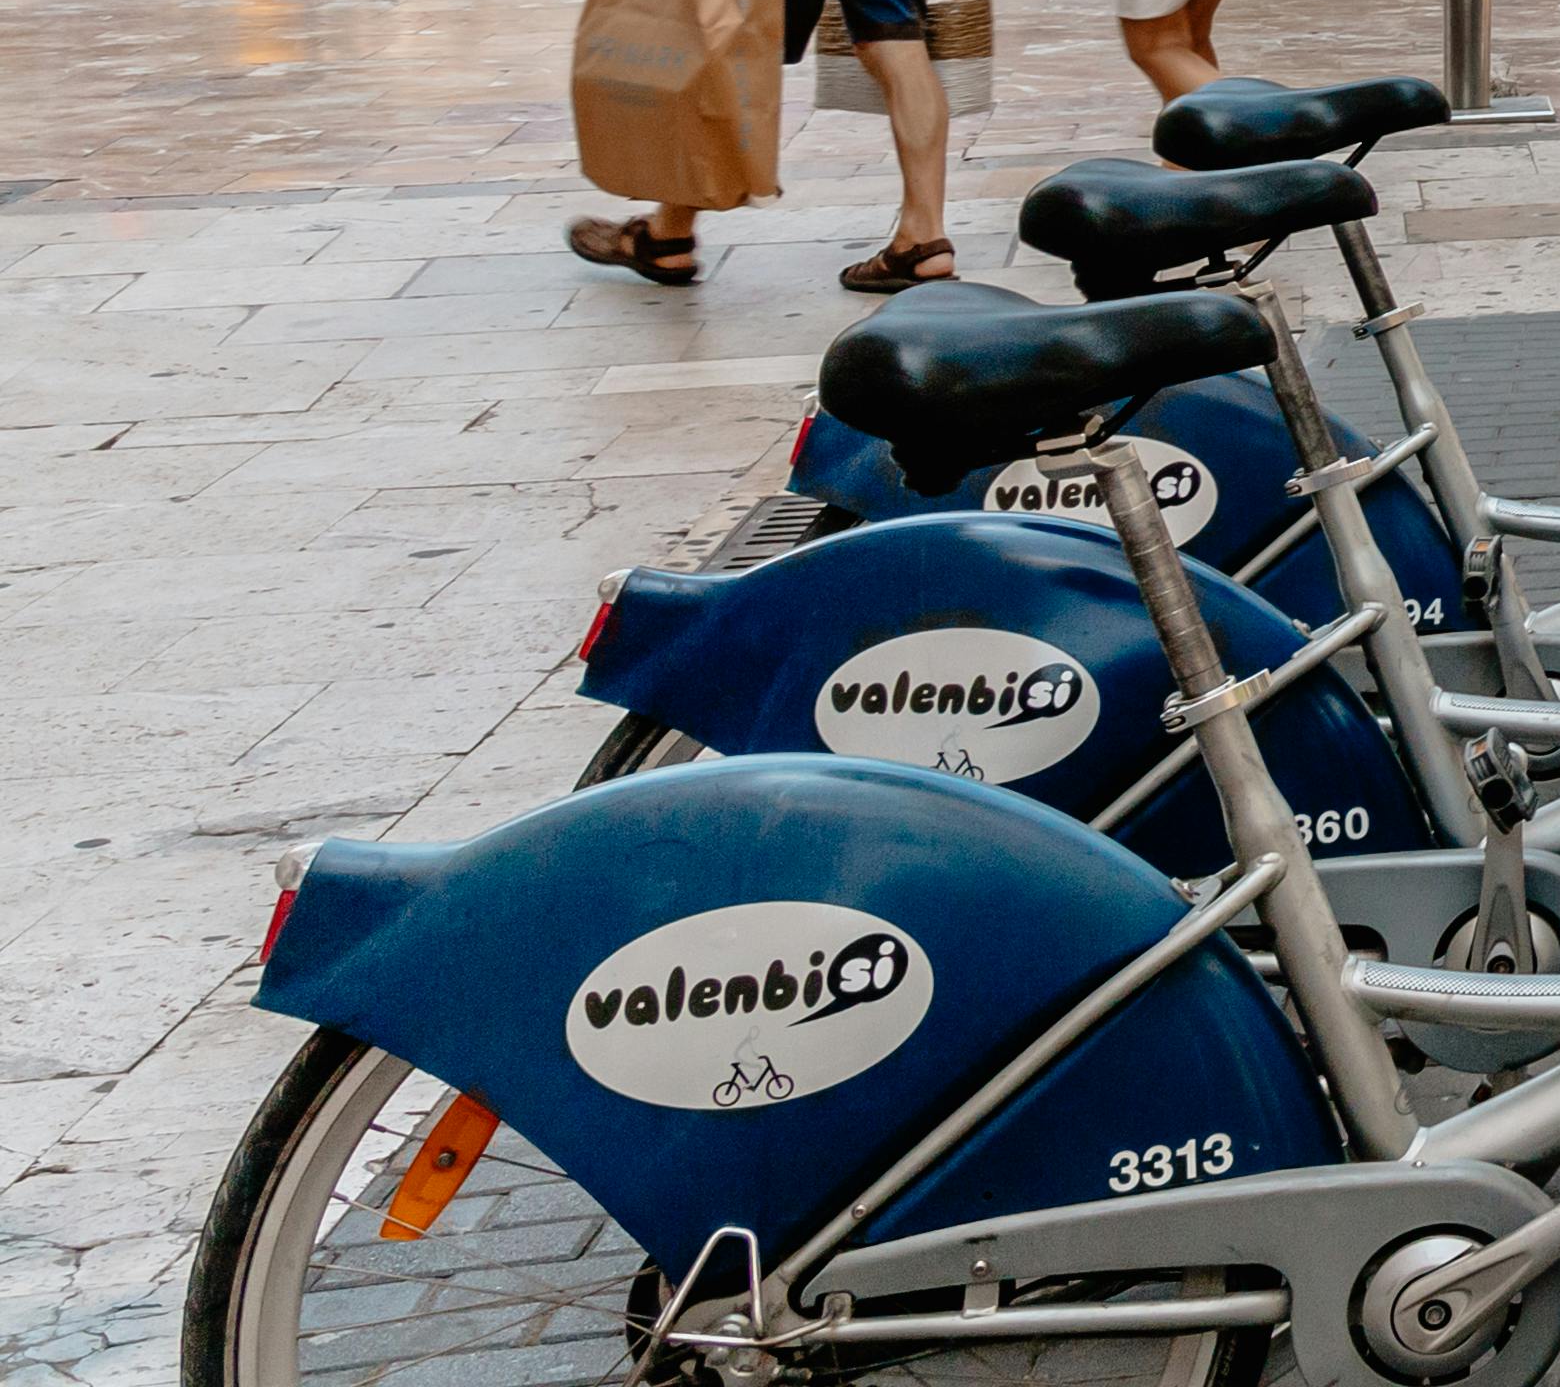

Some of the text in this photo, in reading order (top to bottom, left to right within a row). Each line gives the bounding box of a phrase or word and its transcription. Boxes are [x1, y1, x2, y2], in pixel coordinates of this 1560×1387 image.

[831, 665, 1080, 719] valenbisi
[584, 937, 904, 1030] valenbisi
[1108, 1131, 1234, 1194] 3313
